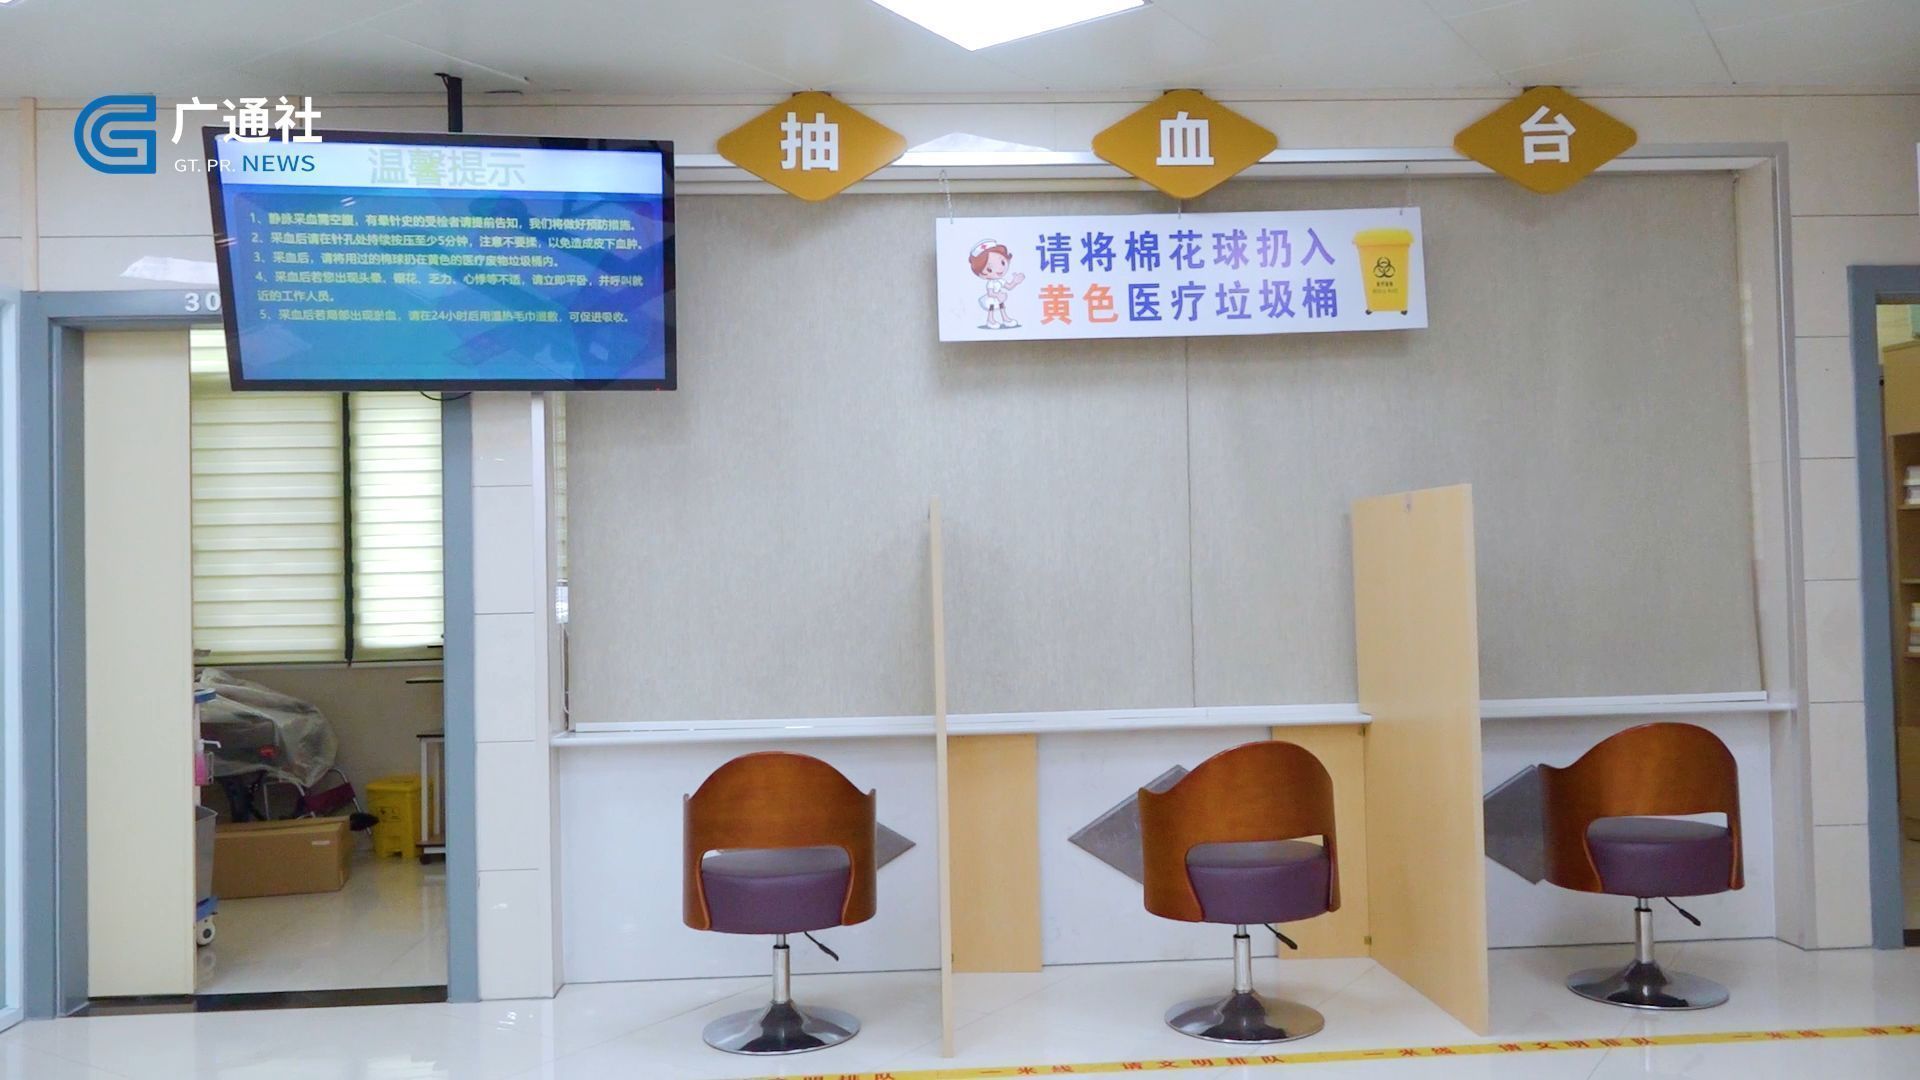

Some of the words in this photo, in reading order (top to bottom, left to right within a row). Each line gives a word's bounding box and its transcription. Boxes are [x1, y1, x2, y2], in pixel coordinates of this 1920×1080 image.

[780, 111, 839, 171] 抽
[1156, 111, 1215, 166] 血
[1519, 105, 1577, 164] 台
[368, 148, 525, 186] 温馨提示
[1036, 227, 1336, 274] 请将棉花球扔入
[1037, 277, 1338, 326] 黄色医疗垃圾桶
[980, 1064, 1075, 1075] 一米线
[1122, 1055, 1285, 1071] 请文明排队
